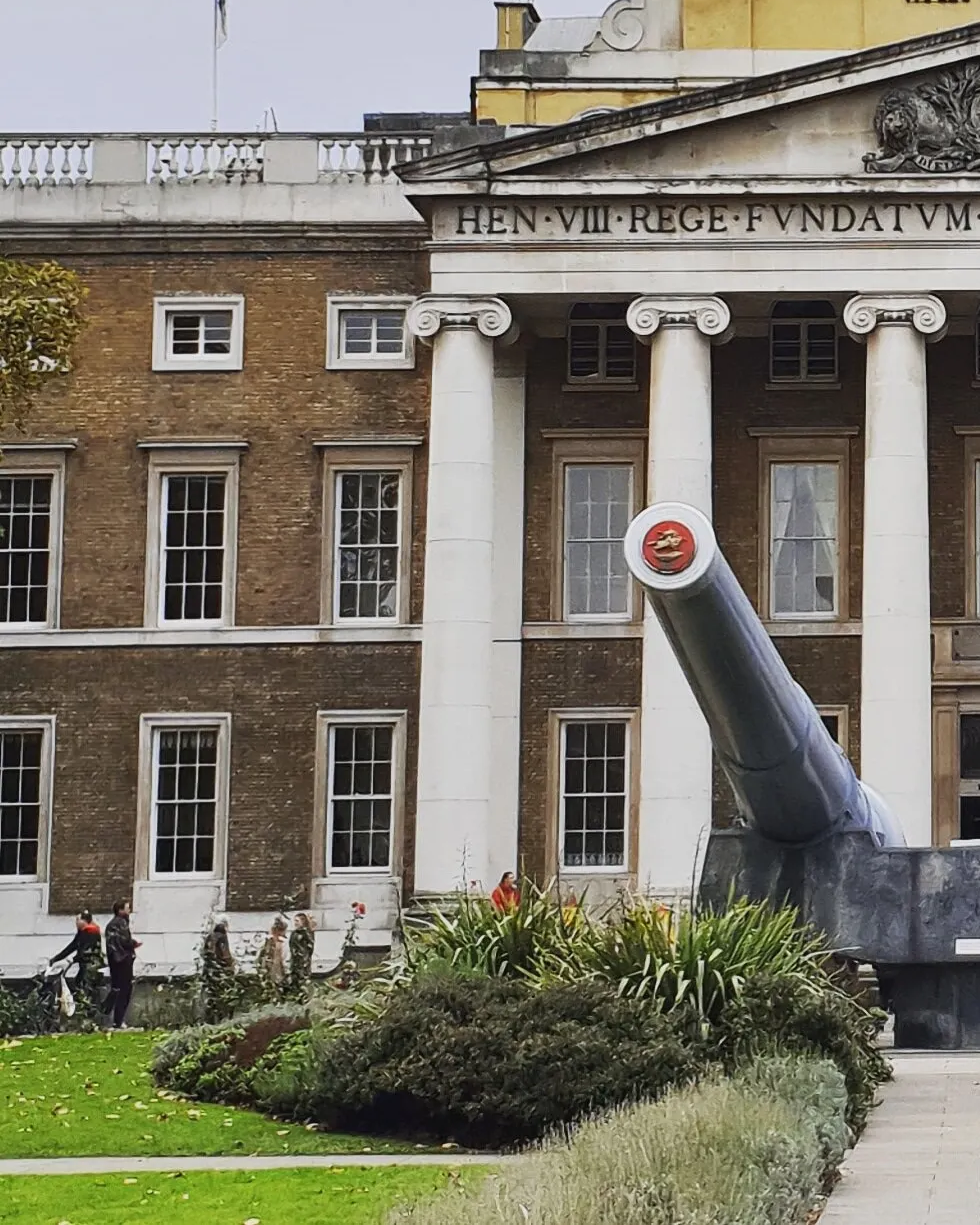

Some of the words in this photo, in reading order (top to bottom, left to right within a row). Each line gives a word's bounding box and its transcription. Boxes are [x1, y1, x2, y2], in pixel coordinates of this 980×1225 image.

[456, 205, 537, 235] HEN
[555, 205, 611, 234] VIII
[628, 203, 729, 233] REGE
[745, 202, 972, 232] FVNDATVM
